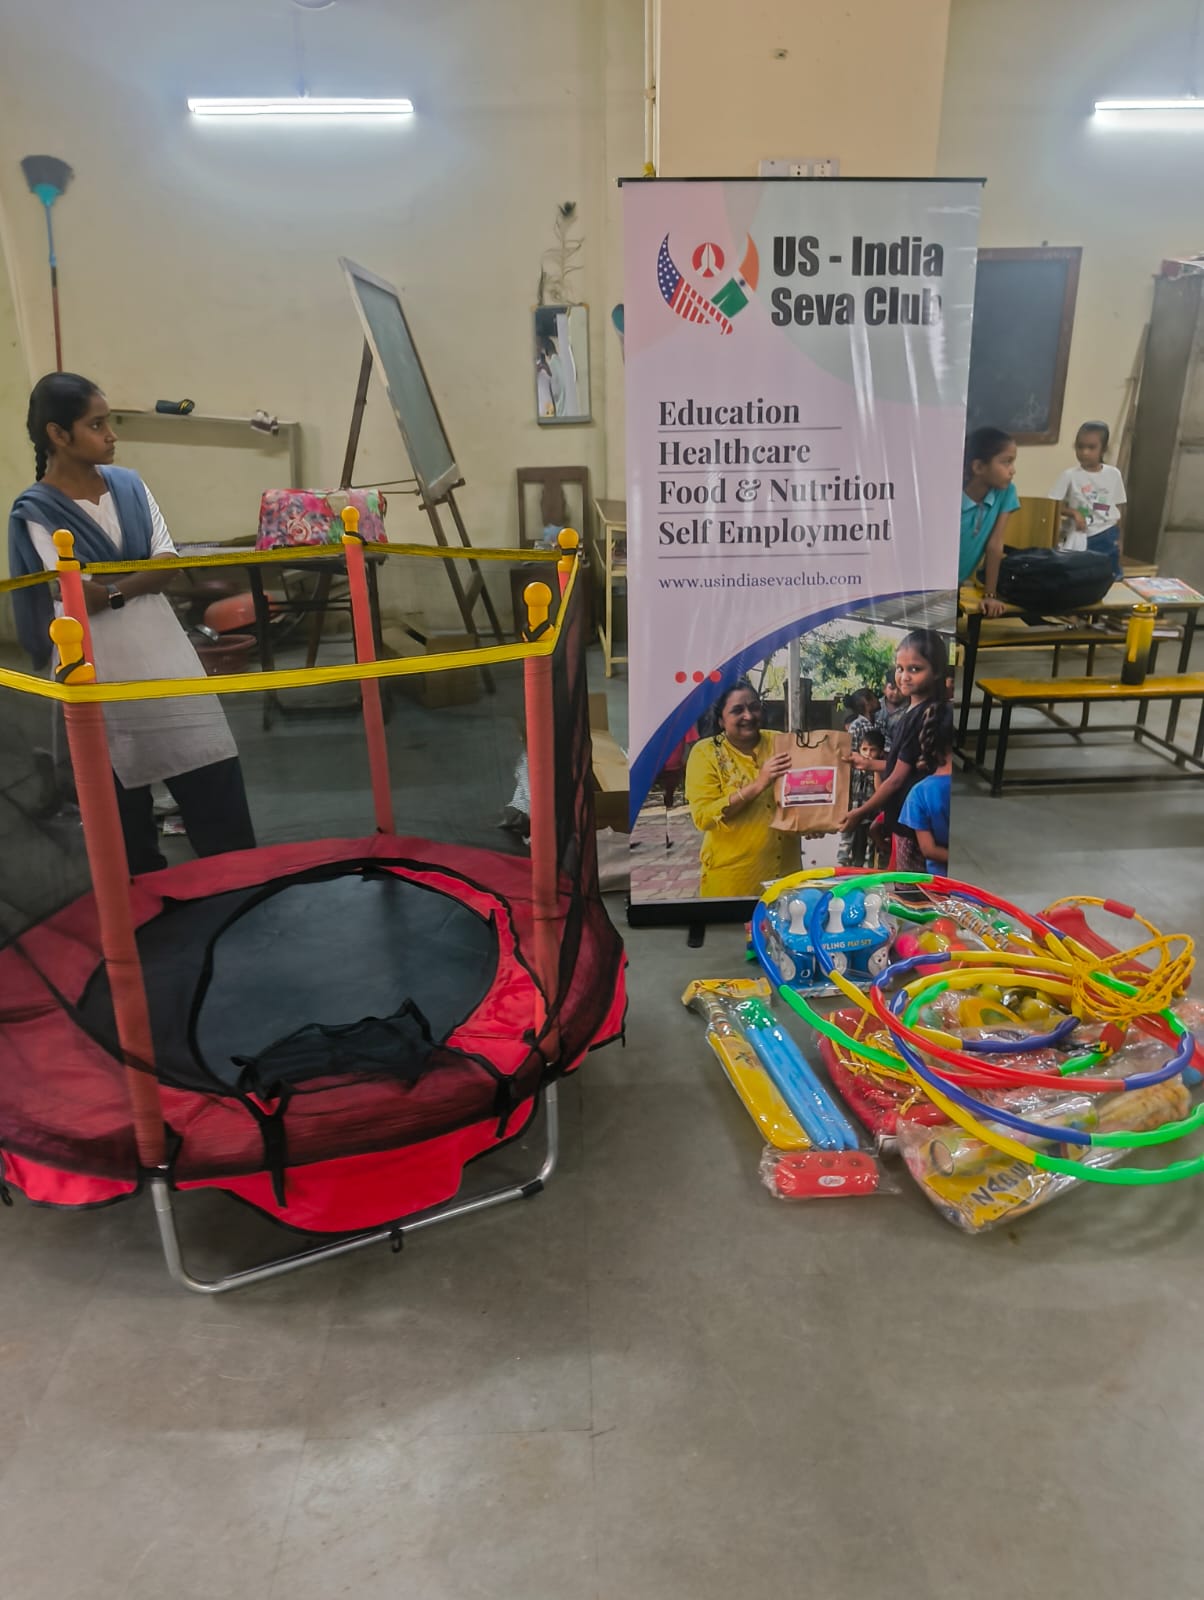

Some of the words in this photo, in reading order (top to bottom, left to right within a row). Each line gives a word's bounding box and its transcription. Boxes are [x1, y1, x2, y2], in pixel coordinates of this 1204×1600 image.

[773, 235, 820, 277] US
[829, 255, 842, 263] -
[851, 236, 944, 277] India
[771, 286, 855, 326] Seva
[863, 286, 942, 326] Club
[659, 398, 800, 426] Education
[659, 438, 811, 465] Healthcare
[659, 478, 727, 504] Food
[735, 479, 761, 503] &
[770, 475, 895, 502] Nutrition
[659, 519, 713, 545] Self
[718, 517, 891, 548] Employment
[659, 572, 862, 589] www.usindiasevaclub.com
[806, 941, 846, 953] BLING
